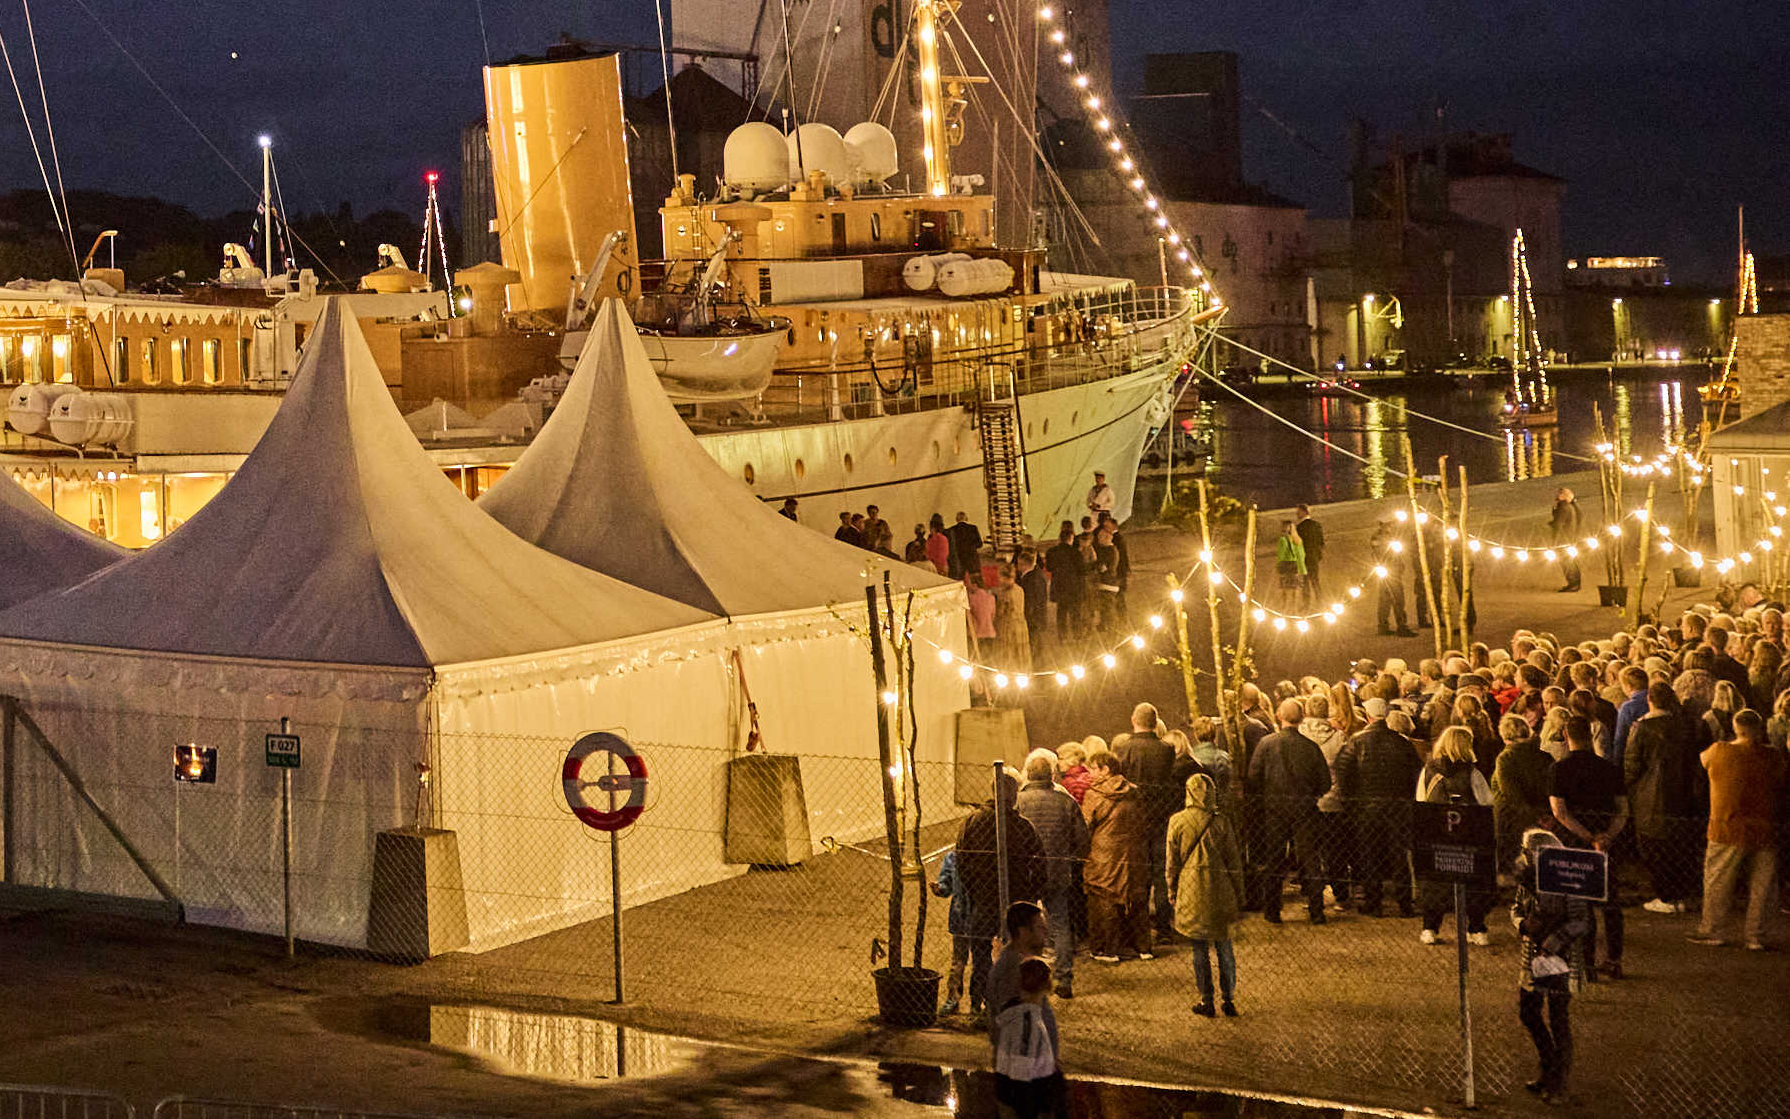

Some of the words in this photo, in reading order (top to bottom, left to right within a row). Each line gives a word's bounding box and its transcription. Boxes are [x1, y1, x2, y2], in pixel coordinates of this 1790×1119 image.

[270, 740, 276, 750] F
[278, 740, 295, 751] 027
[1447, 811, 1461, 832] P
[1548, 859, 1594, 871] PUBLIKUM
